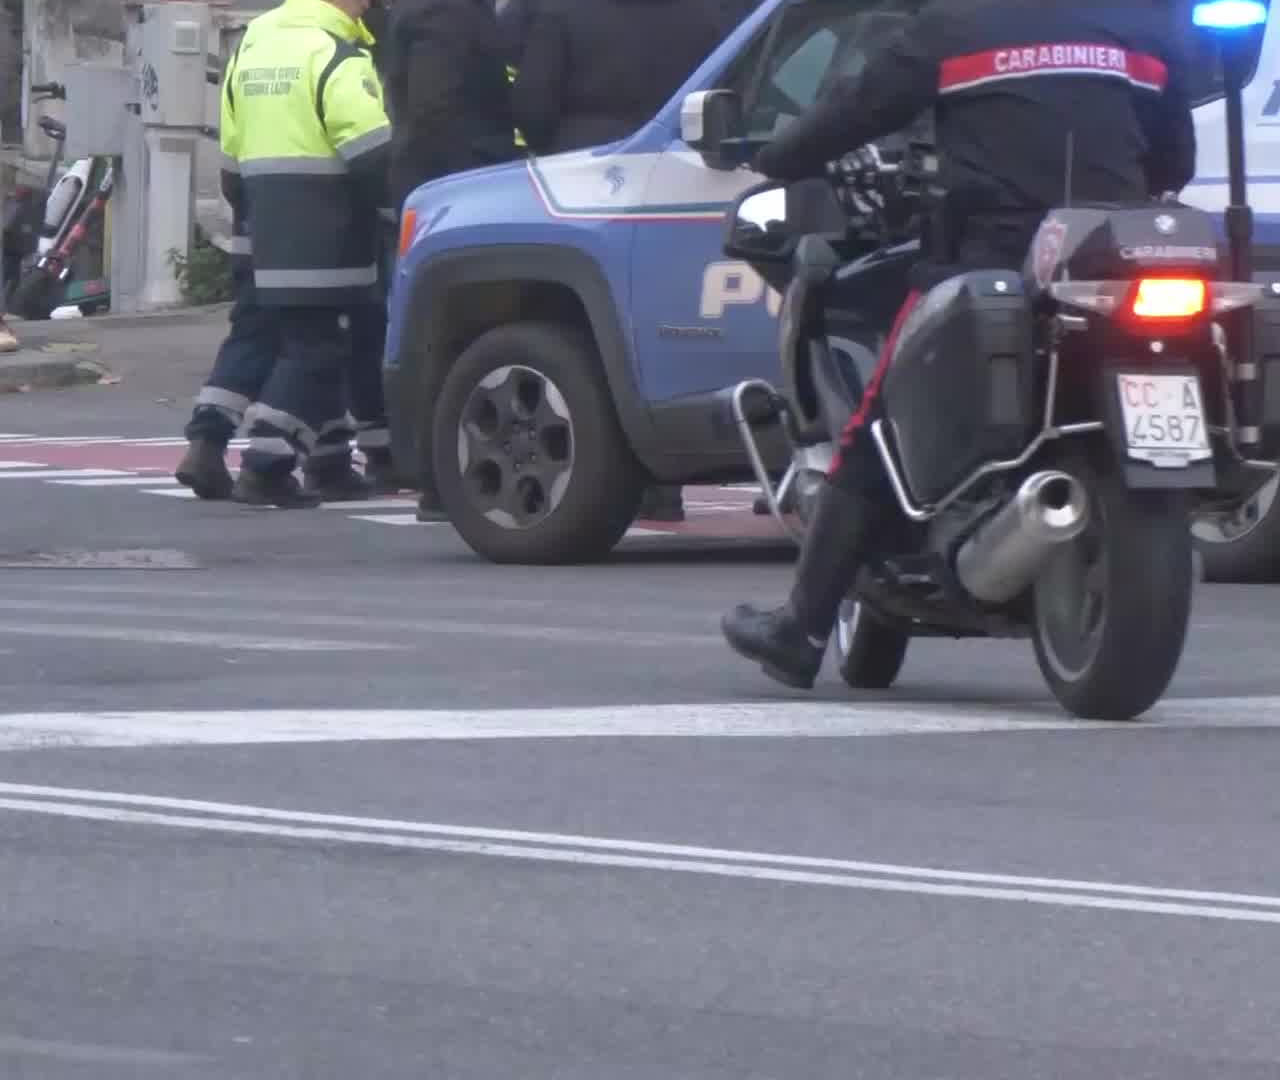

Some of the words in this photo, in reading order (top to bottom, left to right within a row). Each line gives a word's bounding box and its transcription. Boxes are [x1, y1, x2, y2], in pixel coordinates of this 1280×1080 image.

[994, 46, 1126, 72] CARABINIERI
[1120, 246, 1217, 261] CARABINIERI
[1125, 381, 1160, 409] CC
[1182, 383, 1198, 409] A
[1131, 414, 1202, 444] 4587
